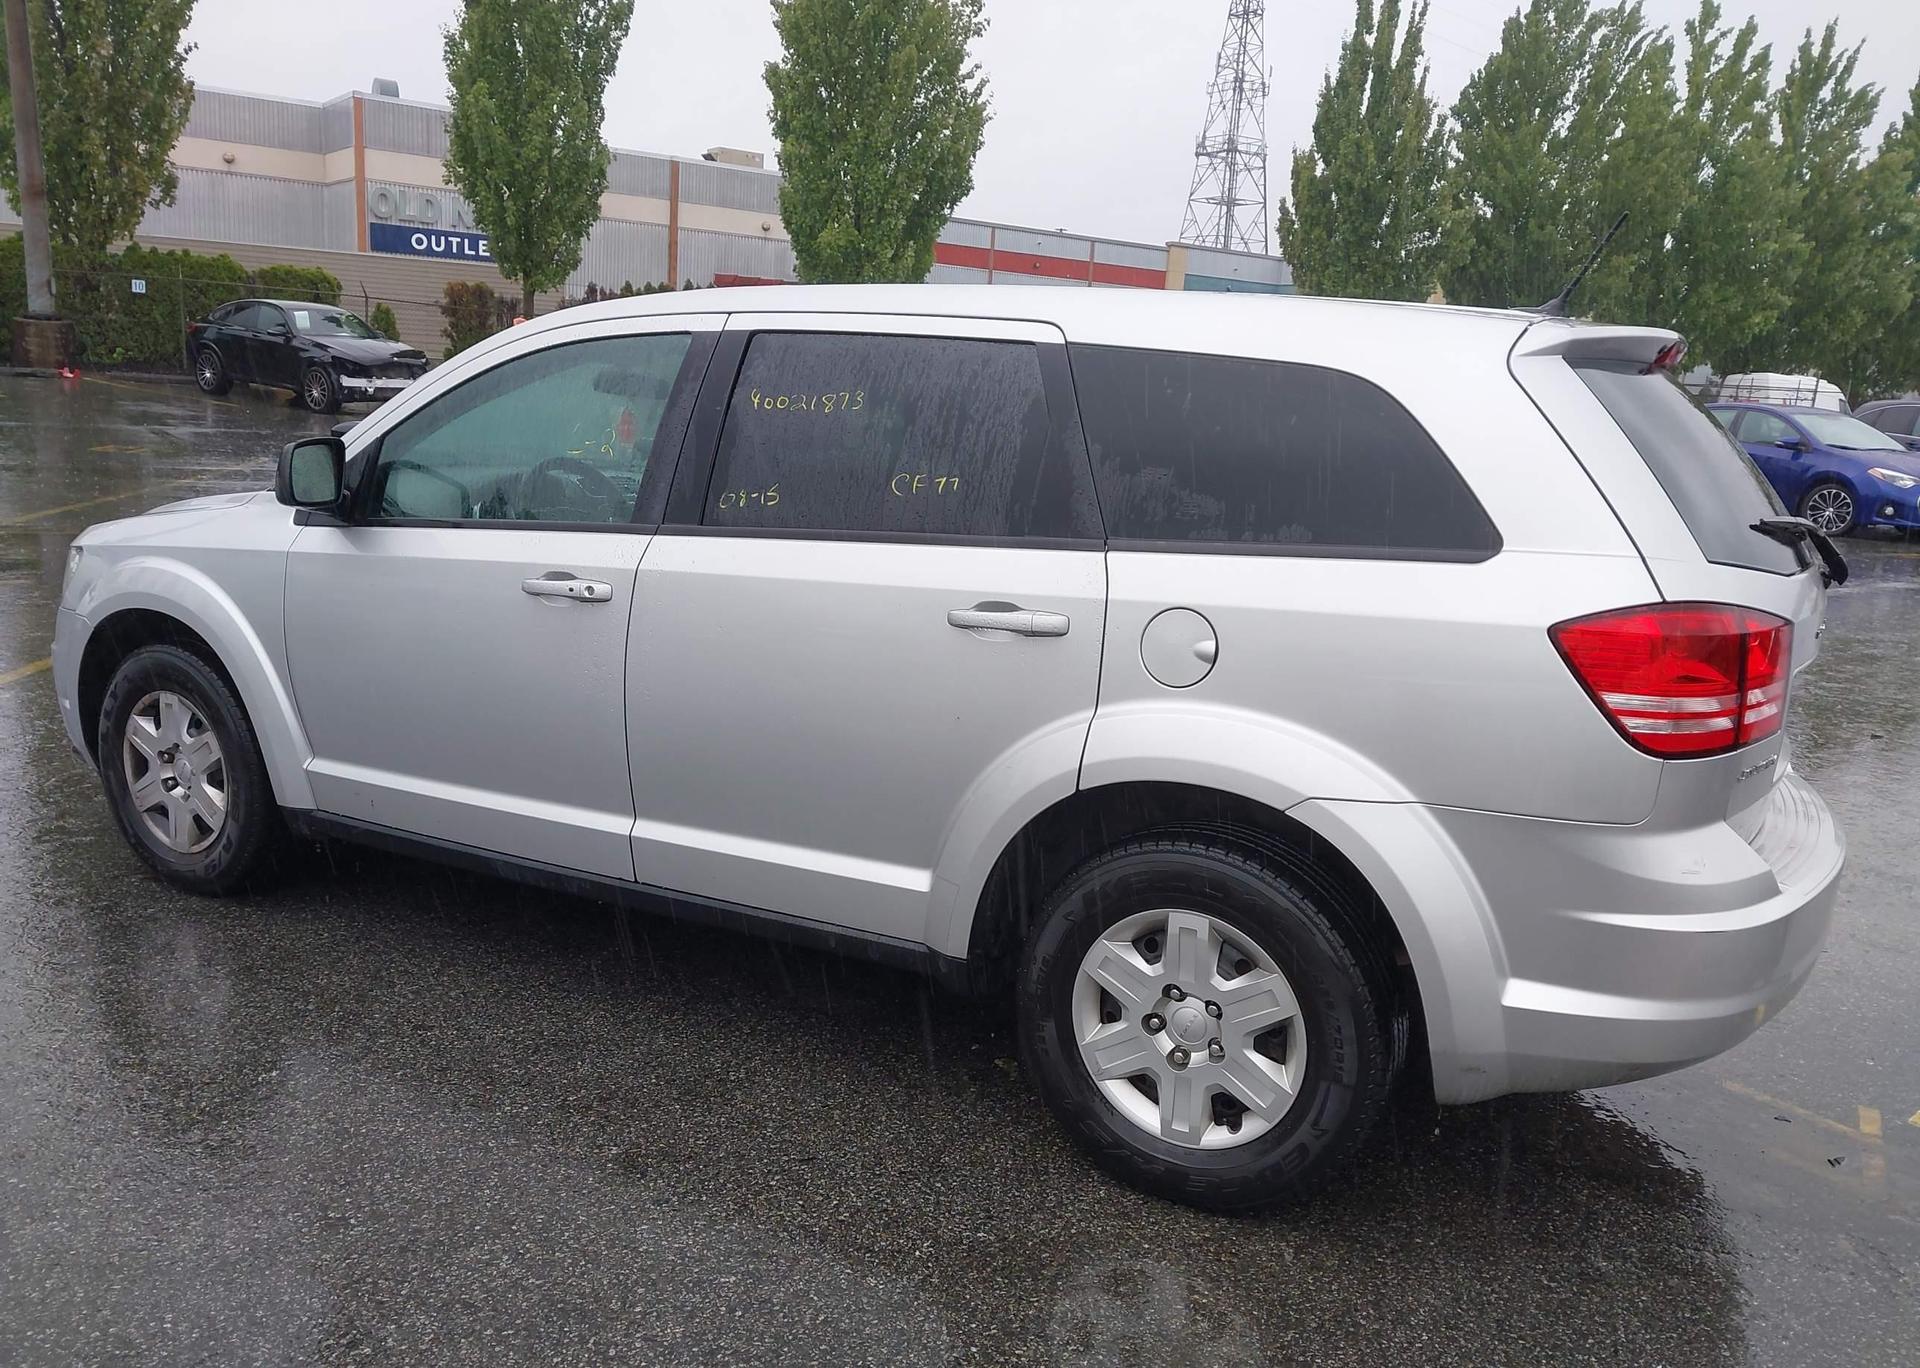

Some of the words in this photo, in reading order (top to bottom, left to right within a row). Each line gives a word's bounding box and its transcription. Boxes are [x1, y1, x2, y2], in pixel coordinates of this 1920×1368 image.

[370, 186, 443, 223] OLD
[410, 232, 491, 257] OUTLE
[751, 388, 865, 413] 40021873
